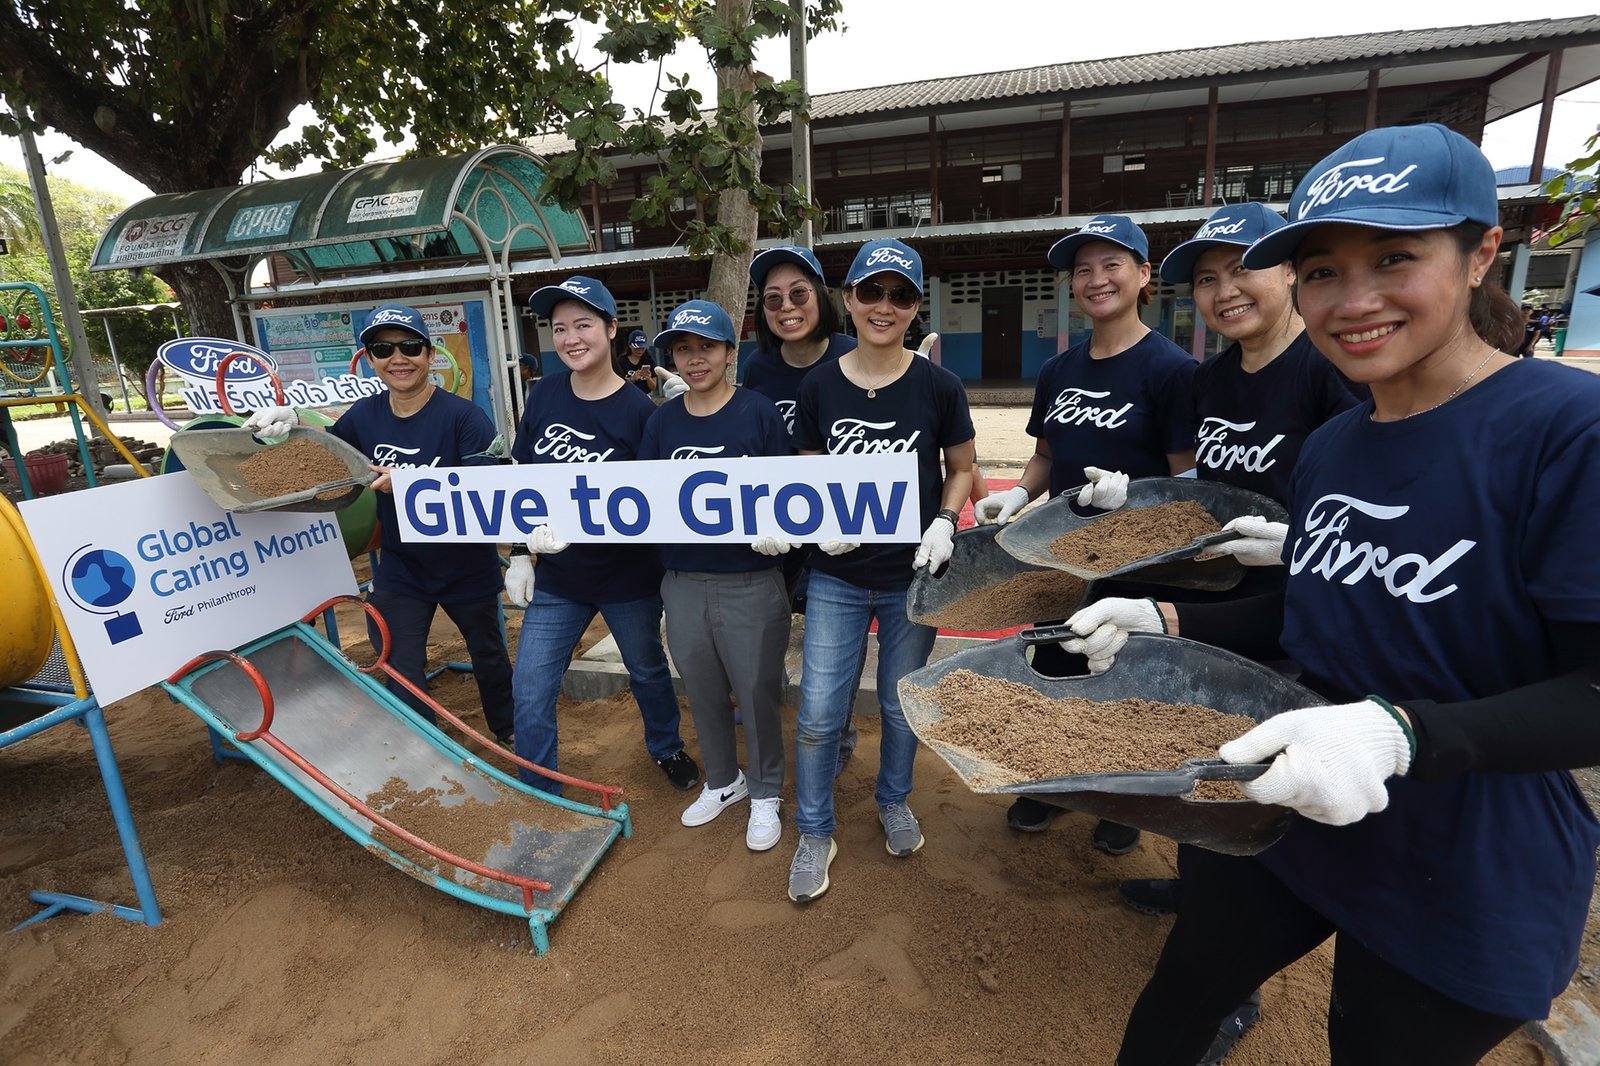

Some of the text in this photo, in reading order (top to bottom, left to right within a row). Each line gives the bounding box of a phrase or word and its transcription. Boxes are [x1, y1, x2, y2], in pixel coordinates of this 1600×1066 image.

[355, 196, 390, 209] CPAC
[1298, 156, 1417, 219] Ford
[150, 218, 187, 235] SCG
[233, 204, 292, 238] CPAC
[1080, 220, 1118, 234] Ford
[1196, 216, 1247, 239] Ford
[120, 239, 178, 252] FOUNDATION
[866, 247, 914, 270] Ford
[559, 281, 591, 295] Ford
[372, 309, 414, 325] Ford
[671, 309, 713, 329] Ford
[190, 345, 257, 374] Frd
[1044, 387, 1134, 430] Ford
[534, 423, 615, 463] Ford
[827, 418, 921, 455] Ford
[1195, 417, 1286, 474] Ford
[404, 470, 909, 537] Give to Grow
[136, 511, 241, 562] Global
[1289, 493, 1477, 605] Ford
[149, 519, 338, 598] Caring Month
[163, 584, 257, 625] Ford Philanthropy
